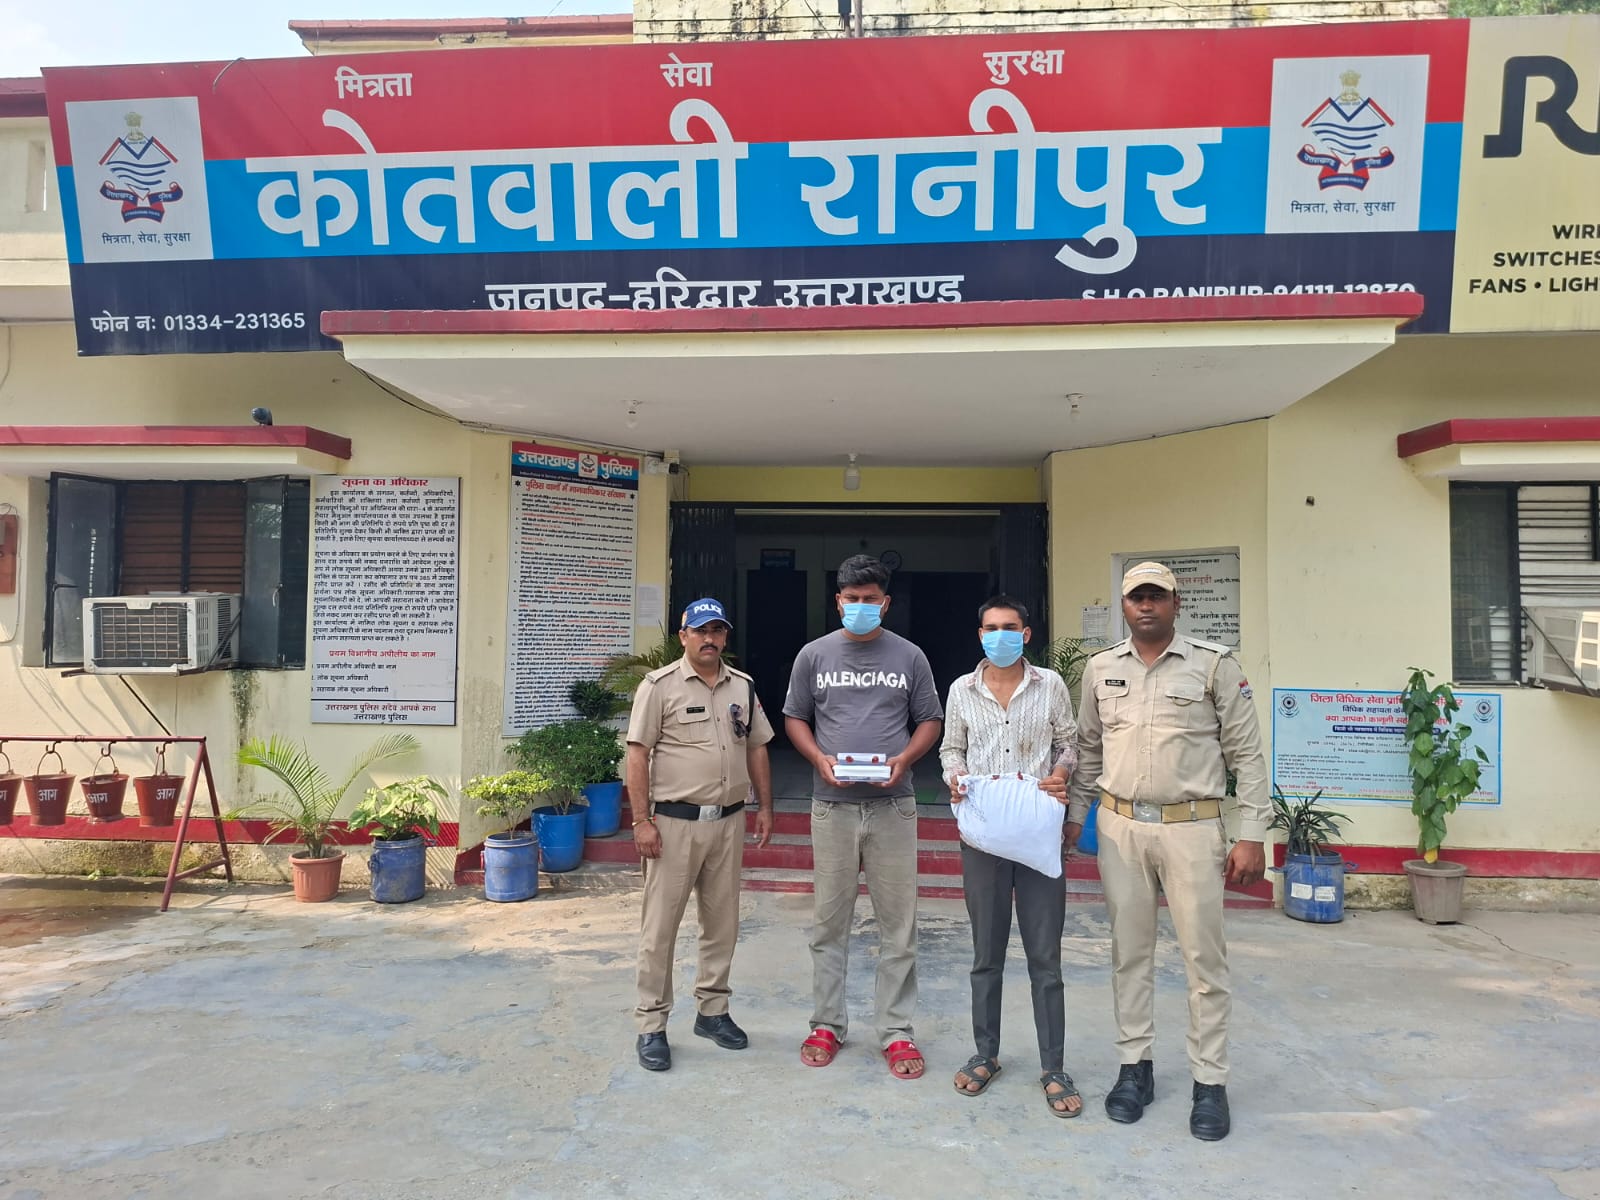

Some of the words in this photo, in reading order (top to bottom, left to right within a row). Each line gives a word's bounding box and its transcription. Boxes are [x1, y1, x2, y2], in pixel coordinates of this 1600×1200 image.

[335, 66, 412, 99] मित्रता
[660, 52, 713, 87] सेवा
[983, 49, 1065, 85] सुरक्षा
[1482, 55, 1600, 158] R
[245, 98, 749, 247] कोतवाली
[789, 88, 1222, 275] रानीपुर
[1291, 200, 1328, 214] मित्रता,
[1333, 200, 1359, 214] सेवा,
[1364, 201, 1396, 216] सुरक्षा
[102, 232, 135, 245] मित्रता,
[137, 231, 160, 244] सेवा,
[164, 232, 191, 246] सुरक्षा
[1552, 224, 1600, 239] WIR
[485, 266, 761, 311] जनपद-हरिद्वार
[774, 275, 964, 308] उत्तराखण्ड
[1469, 278, 1527, 294] FANS
[1549, 276, 1600, 292] LIGH
[90, 309, 129, 333] फोन
[164, 312, 305, 331] 01334-231365
[518, 450, 578, 470] उत्तराखण्ड
[601, 458, 633, 479] पुलिस
[341, 478, 369, 488] सूचना
[373, 478, 385, 487] का
[390, 477, 429, 487] अधिकार
[816, 671, 908, 689] BALENCIAGA
[1311, 693, 1334, 703] जिला
[1336, 693, 1363, 704] विधिक
[1367, 694, 1384, 704] सेवा
[1342, 705, 1364, 713] विधिक
[353, 714, 386, 722] उत्तराखण्ड
[1342, 714, 1366, 722] आपको
[0, 789, 7, 801] ग
[38, 788, 58, 802] आग
[88, 792, 108, 804] आग
[156, 787, 176, 800] आग
